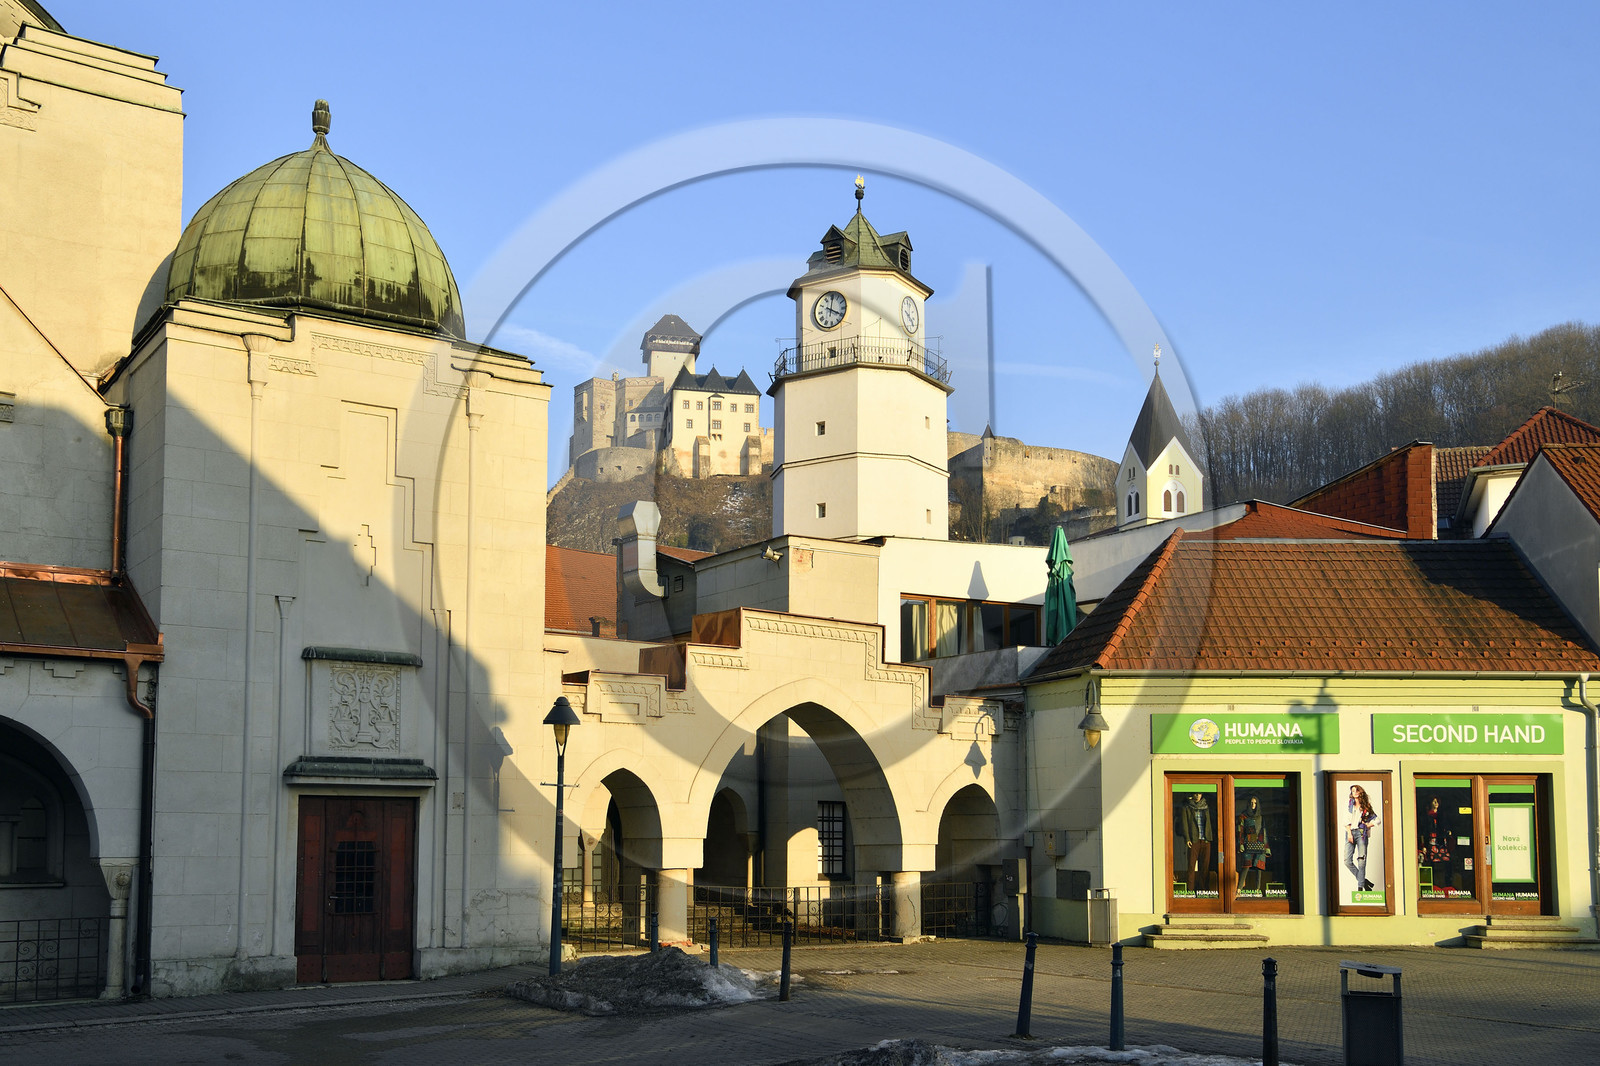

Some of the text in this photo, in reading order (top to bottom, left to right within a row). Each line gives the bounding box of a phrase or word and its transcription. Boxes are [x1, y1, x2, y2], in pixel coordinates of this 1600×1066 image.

[1224, 722, 1304, 737] HUMANA
[1392, 724, 1545, 743] SECOND HAND
[1502, 834, 1520, 842] Nová
